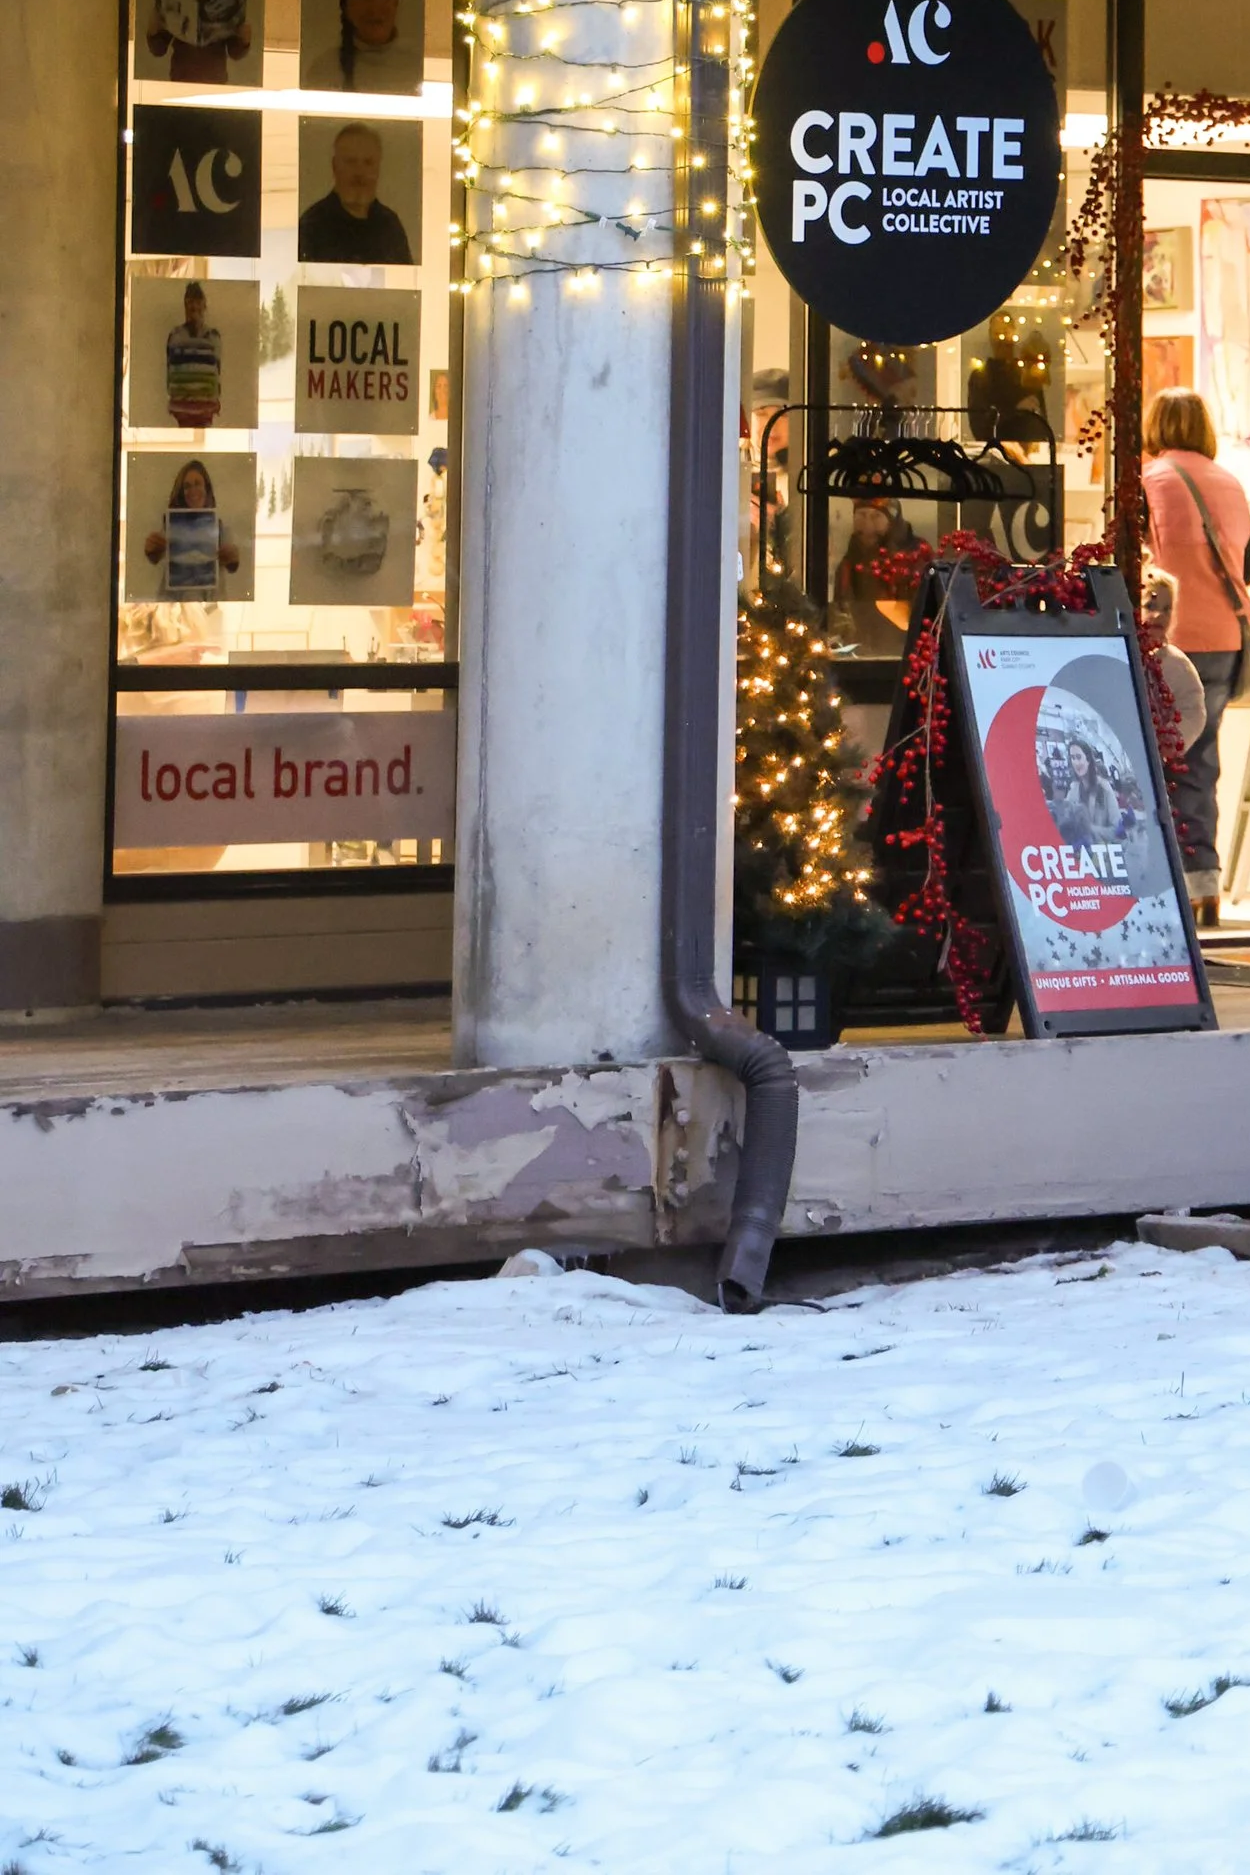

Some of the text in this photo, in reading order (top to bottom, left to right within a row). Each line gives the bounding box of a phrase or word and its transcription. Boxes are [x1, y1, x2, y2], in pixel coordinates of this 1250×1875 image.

[868, 0, 952, 65] AC
[790, 109, 1024, 180] CREATE
[791, 179, 872, 245] PC
[882, 187, 1004, 211] LOCAL ARTIST
[882, 213, 990, 236] COLLECTIVE
[309, 319, 408, 366] LOCAL
[307, 369, 409, 402] MAKERS
[141, 744, 425, 802] local brand.
[1021, 844, 1128, 880] CREATE
[1028, 883, 1069, 918] PC
[1067, 885, 1131, 898] HOLIDAY MAKERS
[1070, 899, 1100, 911] MARKET
[1036, 972, 1190, 990] UNIQUE GIFTS ARTISANAL GOODS
